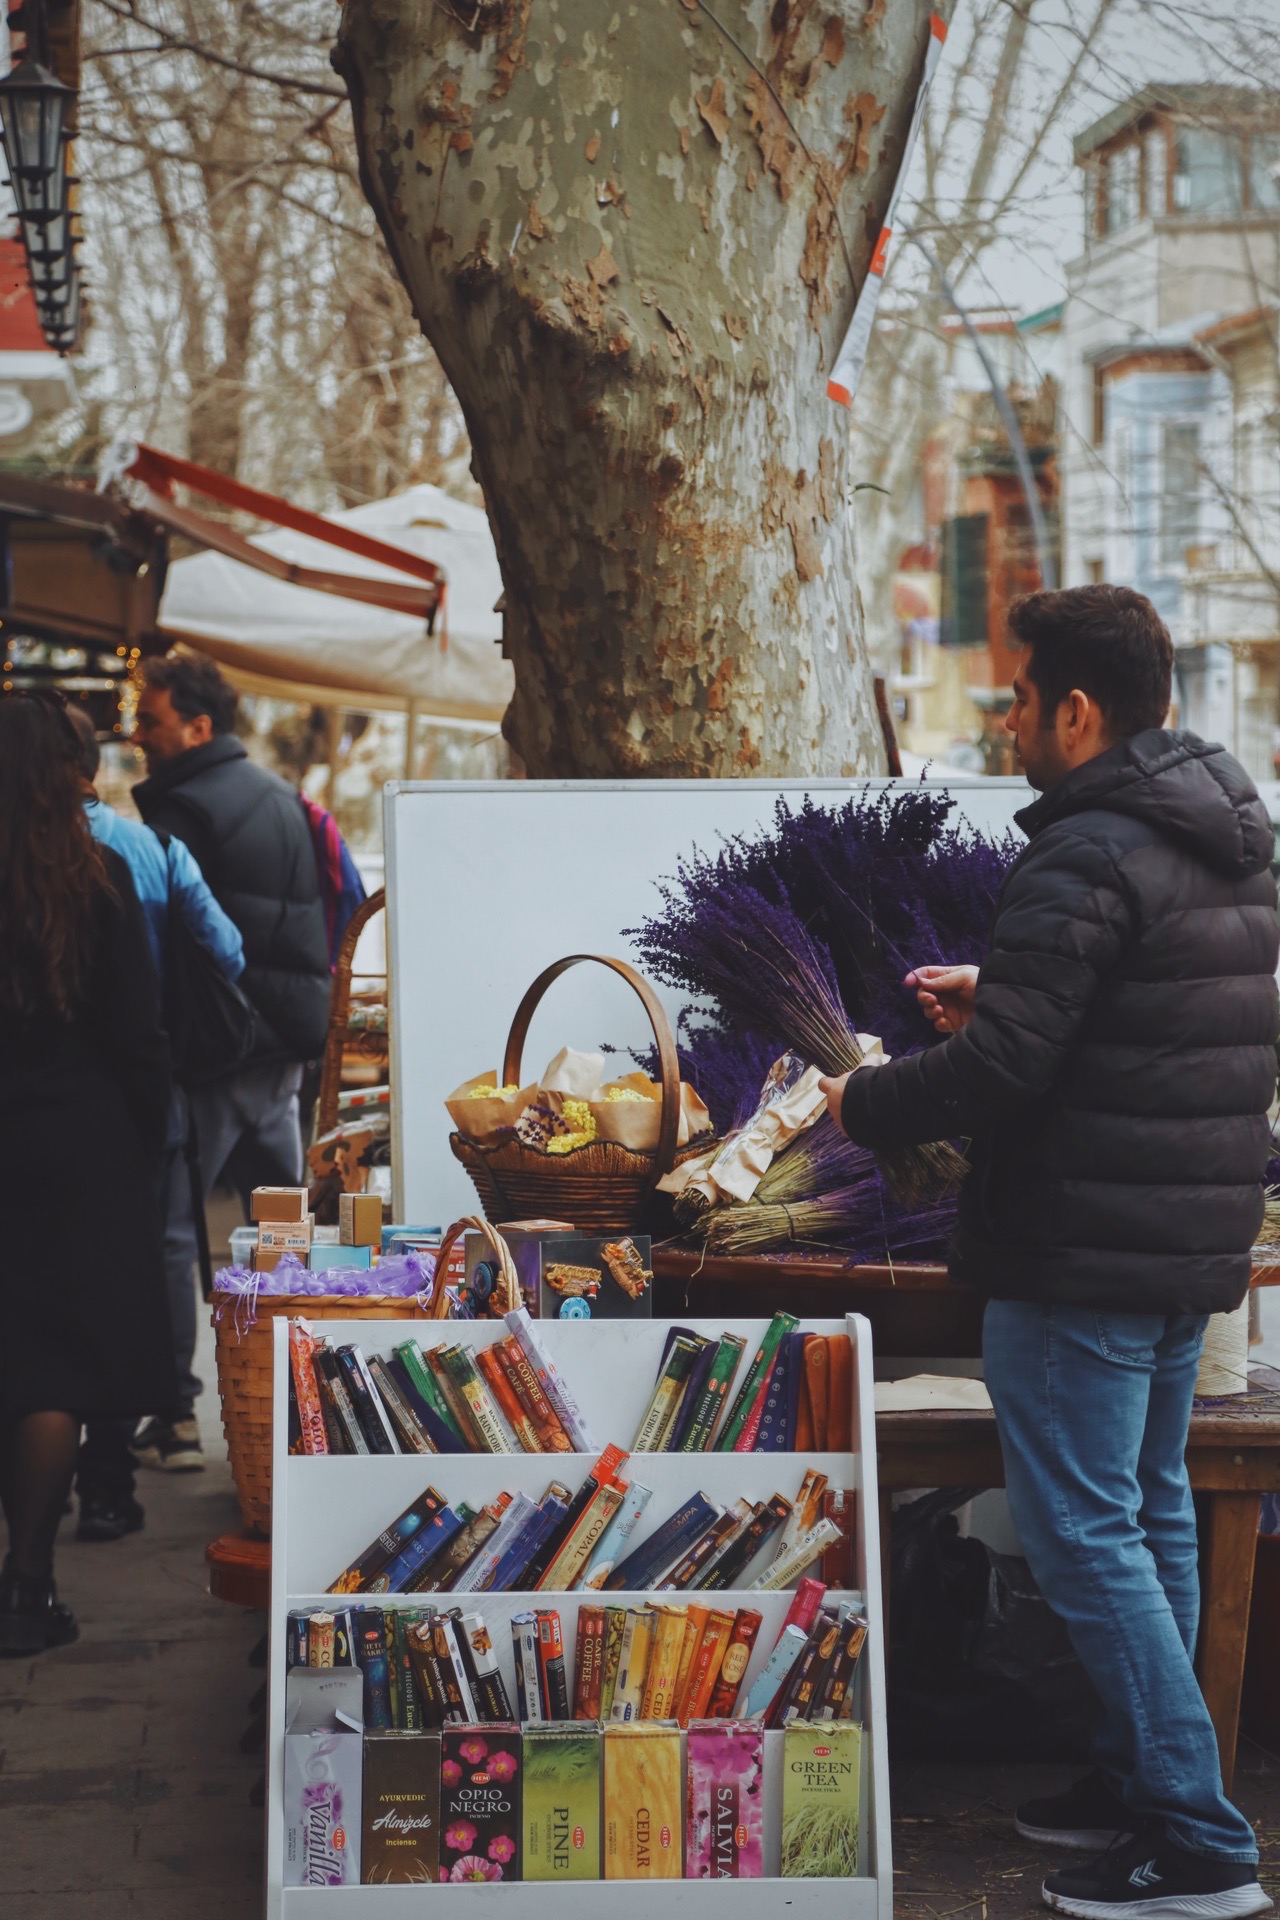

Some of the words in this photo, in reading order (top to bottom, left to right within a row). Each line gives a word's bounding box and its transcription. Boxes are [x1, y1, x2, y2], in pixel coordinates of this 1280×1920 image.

[507, 1368, 525, 1395] CAFÉ
[517, 1362, 543, 1402] COFFEE
[743, 1364, 757, 1391] PRECIOUS
[545, 1385, 567, 1420] Vanilla
[555, 1378, 579, 1416] Vanilla
[697, 1393, 712, 1423] PRECIOUS
[479, 1414, 492, 1433] RAIN
[488, 1409, 499, 1428] RAIN
[643, 1408, 660, 1438] FOREST
[654, 1414, 669, 1441] FOREST
[311, 1415, 324, 1454] LOTO
[393, 1532, 401, 1541] LA
[574, 1519, 604, 1559] COPAL
[583, 1638, 594, 1682] COFFEE
[725, 1663, 743, 1674] ROSE
[730, 1652, 745, 1662] RED
[405, 1671, 413, 1702] PRECIOUS
[429, 1656, 441, 1679] Amber
[437, 1680, 449, 1705] Sandal
[470, 1681, 480, 1703] Musc
[690, 1670, 705, 1699] Orange
[485, 1684, 499, 1716] AYURVEDIC
[406, 1705, 415, 1728] Euca
[791, 1762, 852, 1774] GREEN
[804, 1775, 838, 1786] TEA
[379, 1794, 426, 1802] AYURVEDIC
[449, 1801, 511, 1812] NEGRO
[459, 1789, 503, 1800] OPIO
[372, 1808, 431, 1835] Almizcle
[717, 1788, 733, 1878] SALVIA
[309, 1802, 340, 1887] Vanilla
[553, 1806, 569, 1870] PINE
[637, 1808, 650, 1868] CEDAR
